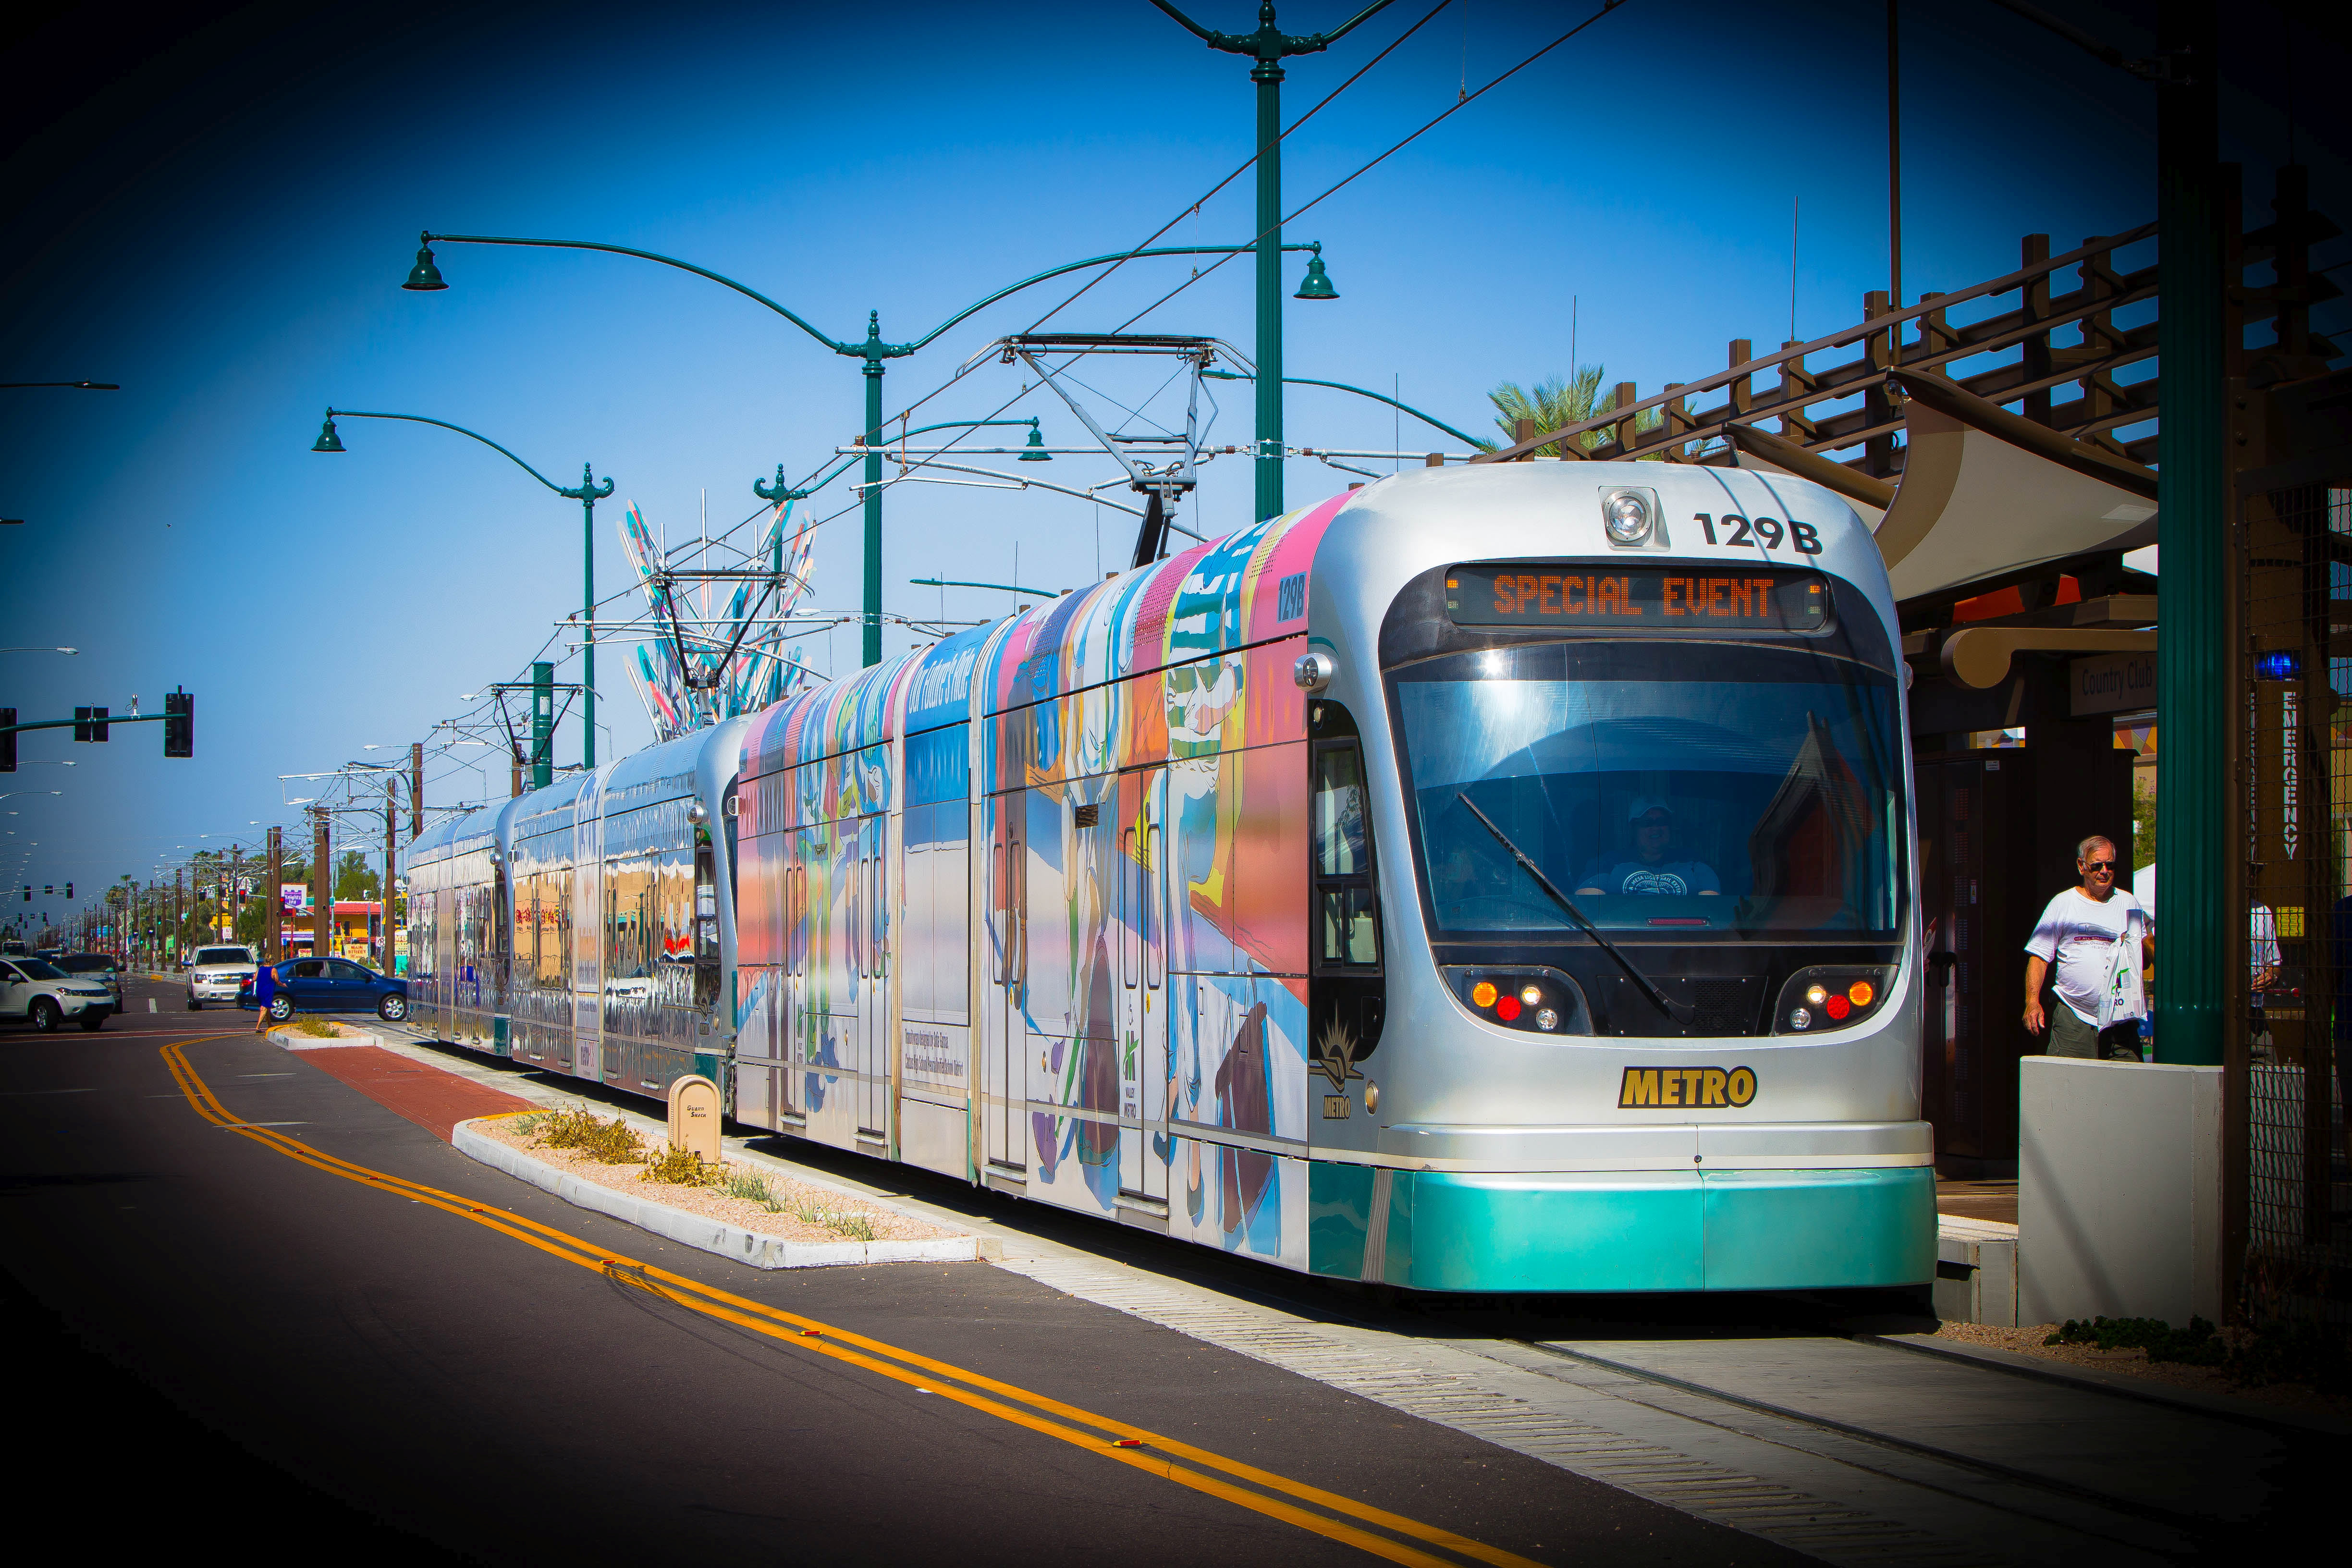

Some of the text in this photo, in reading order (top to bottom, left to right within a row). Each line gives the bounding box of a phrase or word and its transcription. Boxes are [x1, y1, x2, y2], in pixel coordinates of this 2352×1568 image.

[1694, 513, 1823, 555] 129B
[1278, 575, 1305, 622] 129B
[1494, 575, 1773, 617] SPECIAL EVENT
[908, 664, 930, 714] Our
[950, 648, 976, 703] Ride
[2082, 658, 2152, 700] Country Club
[2283, 692, 2297, 860] EMERGENCY
[1632, 875, 1644, 885] MESA
[1125, 1087, 1135, 1099] VALLEY
[1323, 1096, 1351, 1118] METRO
[1621, 1069, 1754, 1106] METRO
[1124, 1102, 1137, 1119] METRO
